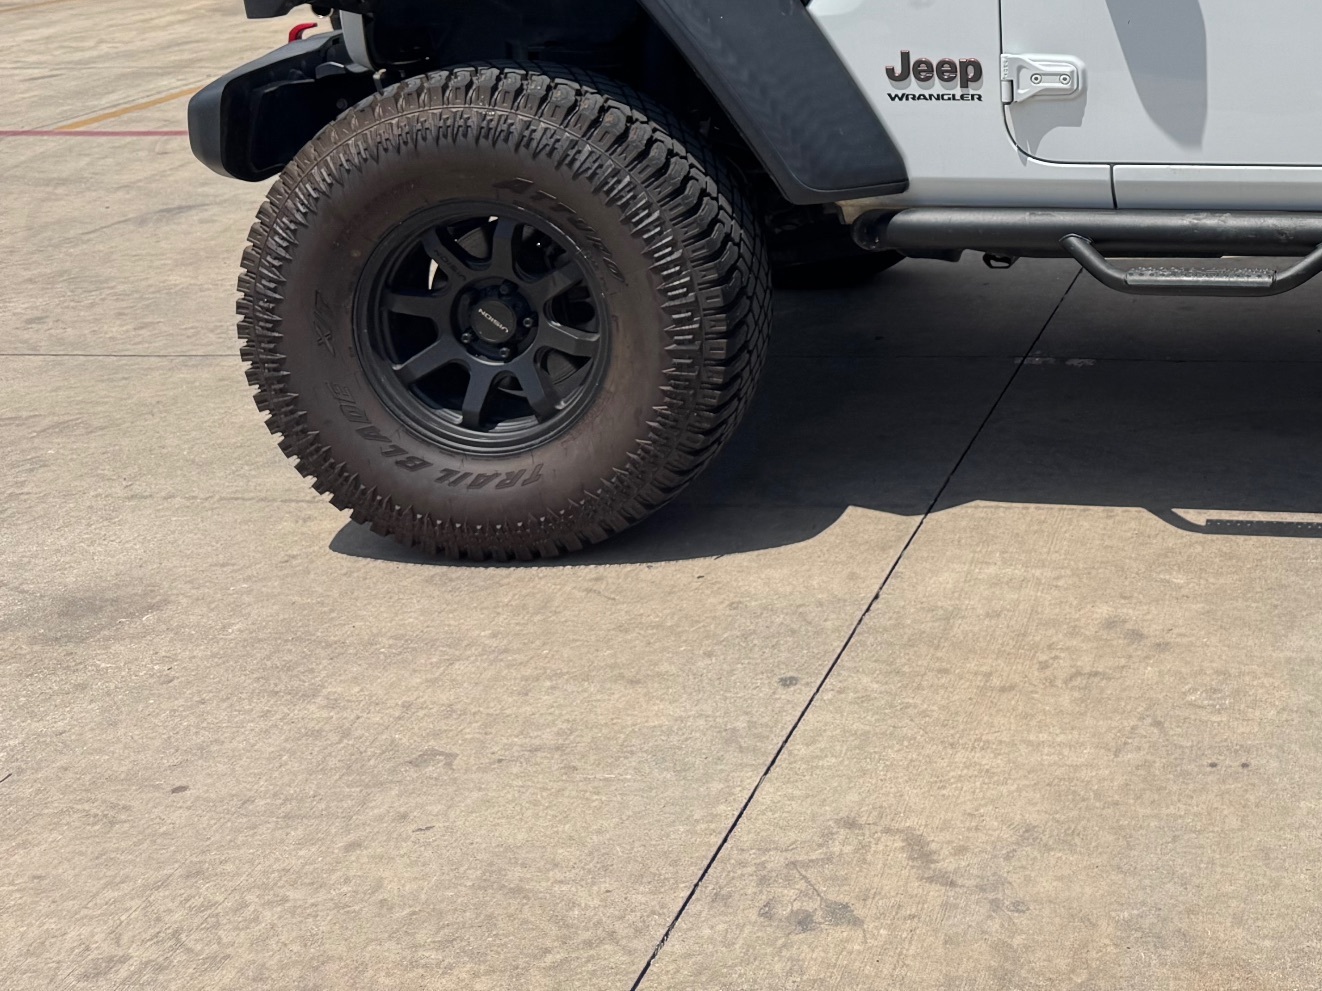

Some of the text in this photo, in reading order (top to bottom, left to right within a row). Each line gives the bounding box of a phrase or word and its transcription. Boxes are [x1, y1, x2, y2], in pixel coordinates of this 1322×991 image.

[885, 50, 983, 89] Jeep
[886, 92, 984, 102] WRANGLER
[478, 308, 510, 334] VISION
[325, 381, 434, 473] BLADE
[434, 463, 545, 490] TRAIL
